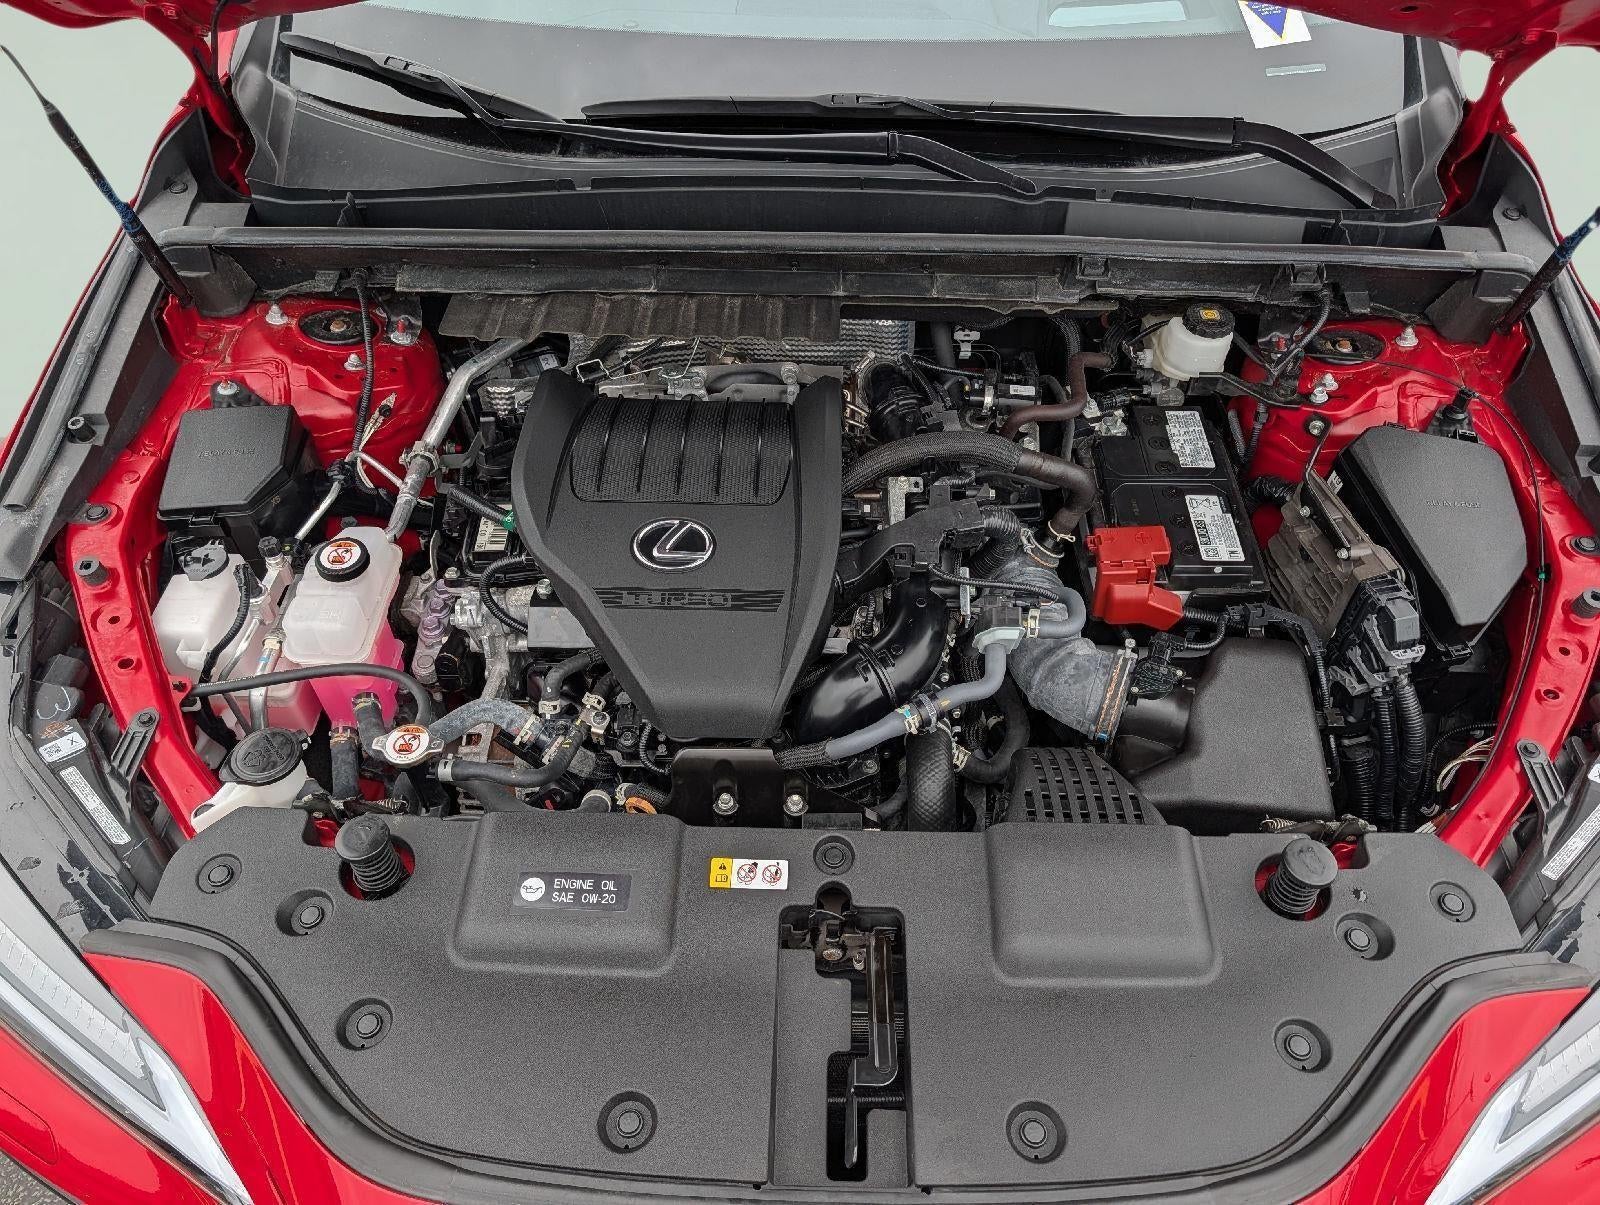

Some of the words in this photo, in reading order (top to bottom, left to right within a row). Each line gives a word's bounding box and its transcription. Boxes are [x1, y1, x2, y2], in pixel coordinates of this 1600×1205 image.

[622, 591, 732, 608] TURBO
[553, 878, 594, 890] ENGINE
[601, 880, 618, 891] OIL
[551, 891, 575, 903] SAE
[581, 893, 616, 904] 0W-20
